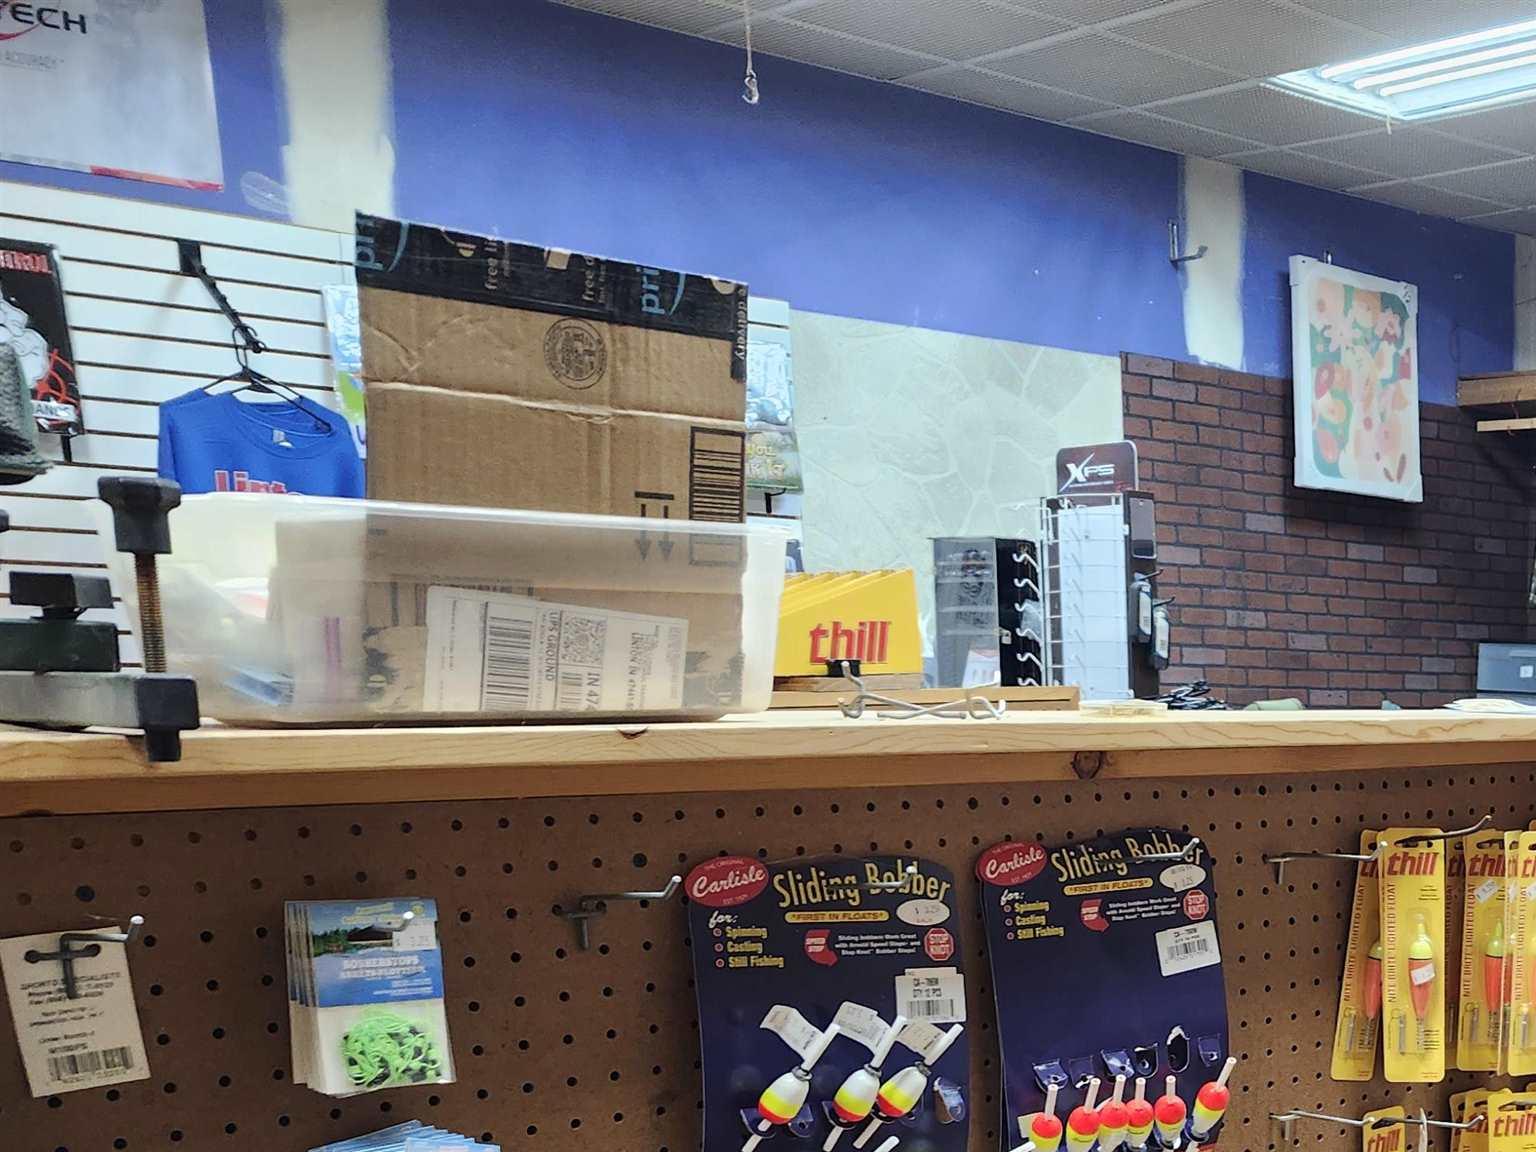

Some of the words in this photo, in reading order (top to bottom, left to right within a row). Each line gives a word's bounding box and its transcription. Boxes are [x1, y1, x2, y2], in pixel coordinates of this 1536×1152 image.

[734, 308, 747, 361] delivery
[1062, 454, 1116, 488] XPS
[547, 609, 559, 631] UPS
[809, 620, 891, 664] thill
[544, 632, 557, 682] GROUND
[587, 672, 600, 687] IN
[985, 848, 1045, 879] Carlisle
[1050, 844, 1128, 883] Sliding
[1125, 831, 1203, 865] Bobber
[1386, 851, 1437, 877] thill
[691, 864, 766, 899] Carlisle
[772, 867, 861, 908] Sliding
[864, 858, 951, 901] Bobber
[1000, 889, 1024, 905] for:
[1013, 901, 1050, 912] Spinning
[708, 909, 738, 928] for:
[1015, 914, 1046, 926] Casting
[725, 926, 768, 939] Spinning
[1017, 928, 1035, 940] Still
[1035, 926, 1065, 938] Fishing
[726, 941, 763, 954] Casting
[728, 956, 749, 969] Still
[749, 955, 785, 968] Fishing
[1493, 1113, 1536, 1137] thill
